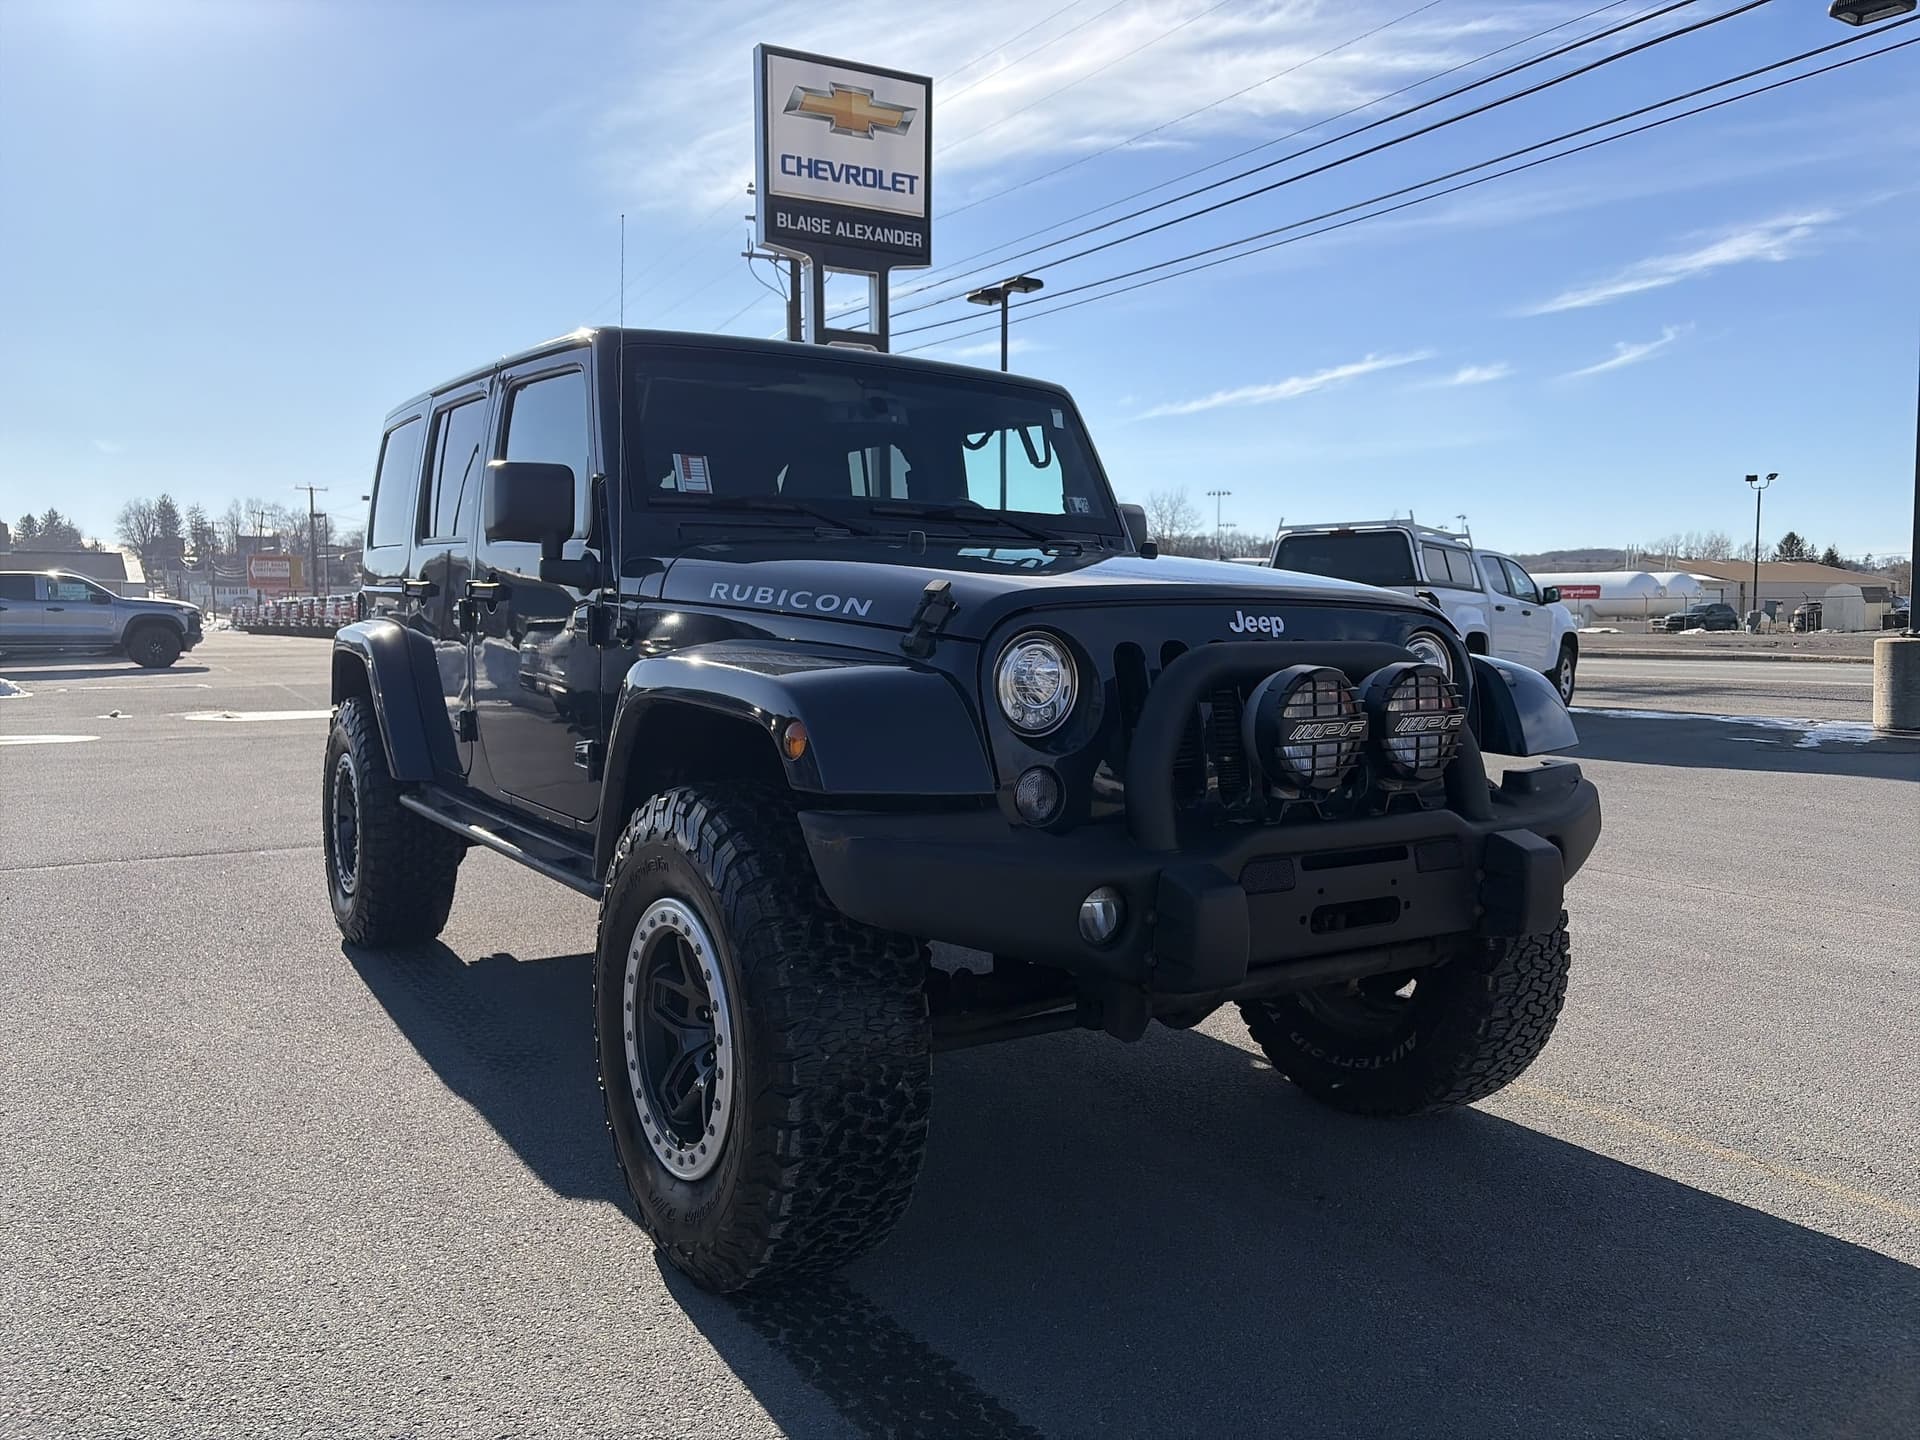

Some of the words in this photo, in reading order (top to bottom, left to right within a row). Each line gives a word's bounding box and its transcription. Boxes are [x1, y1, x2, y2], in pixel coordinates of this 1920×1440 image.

[780, 153, 919, 195] CHEVROLET
[776, 211, 832, 235] BLAISE
[835, 221, 923, 248] ALEXANDER
[709, 582, 873, 617] RUBICON
[1228, 610, 1285, 638] Jeep
